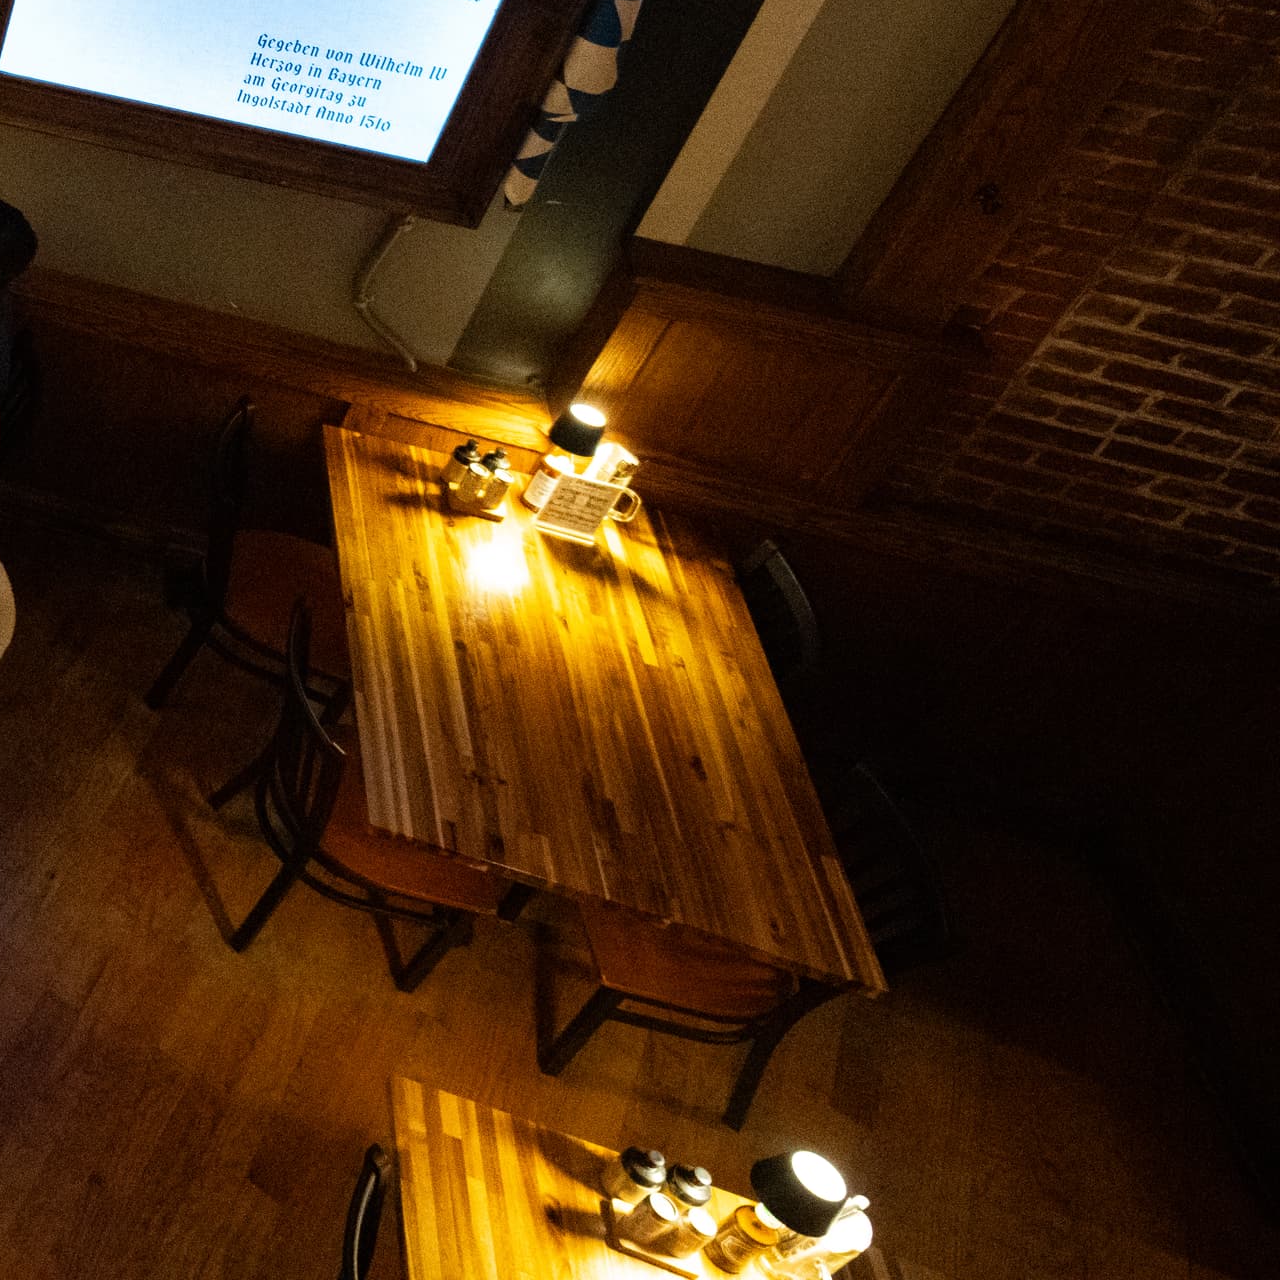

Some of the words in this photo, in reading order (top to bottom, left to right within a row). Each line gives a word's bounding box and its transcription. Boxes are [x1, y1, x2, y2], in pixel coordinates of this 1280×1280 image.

[249, 51, 304, 77] Herzog
[306, 64, 324, 80] in
[326, 66, 383, 91] Bayern
[256, 32, 321, 58] Gegeben
[324, 47, 354, 65] von
[358, 51, 424, 78] Wilhelm
[236, 88, 312, 117] Ingolstadt
[314, 104, 355, 125] Anno
[242, 73, 266, 88] am
[270, 75, 345, 106] Georgitag
[346, 94, 368, 108] zu
